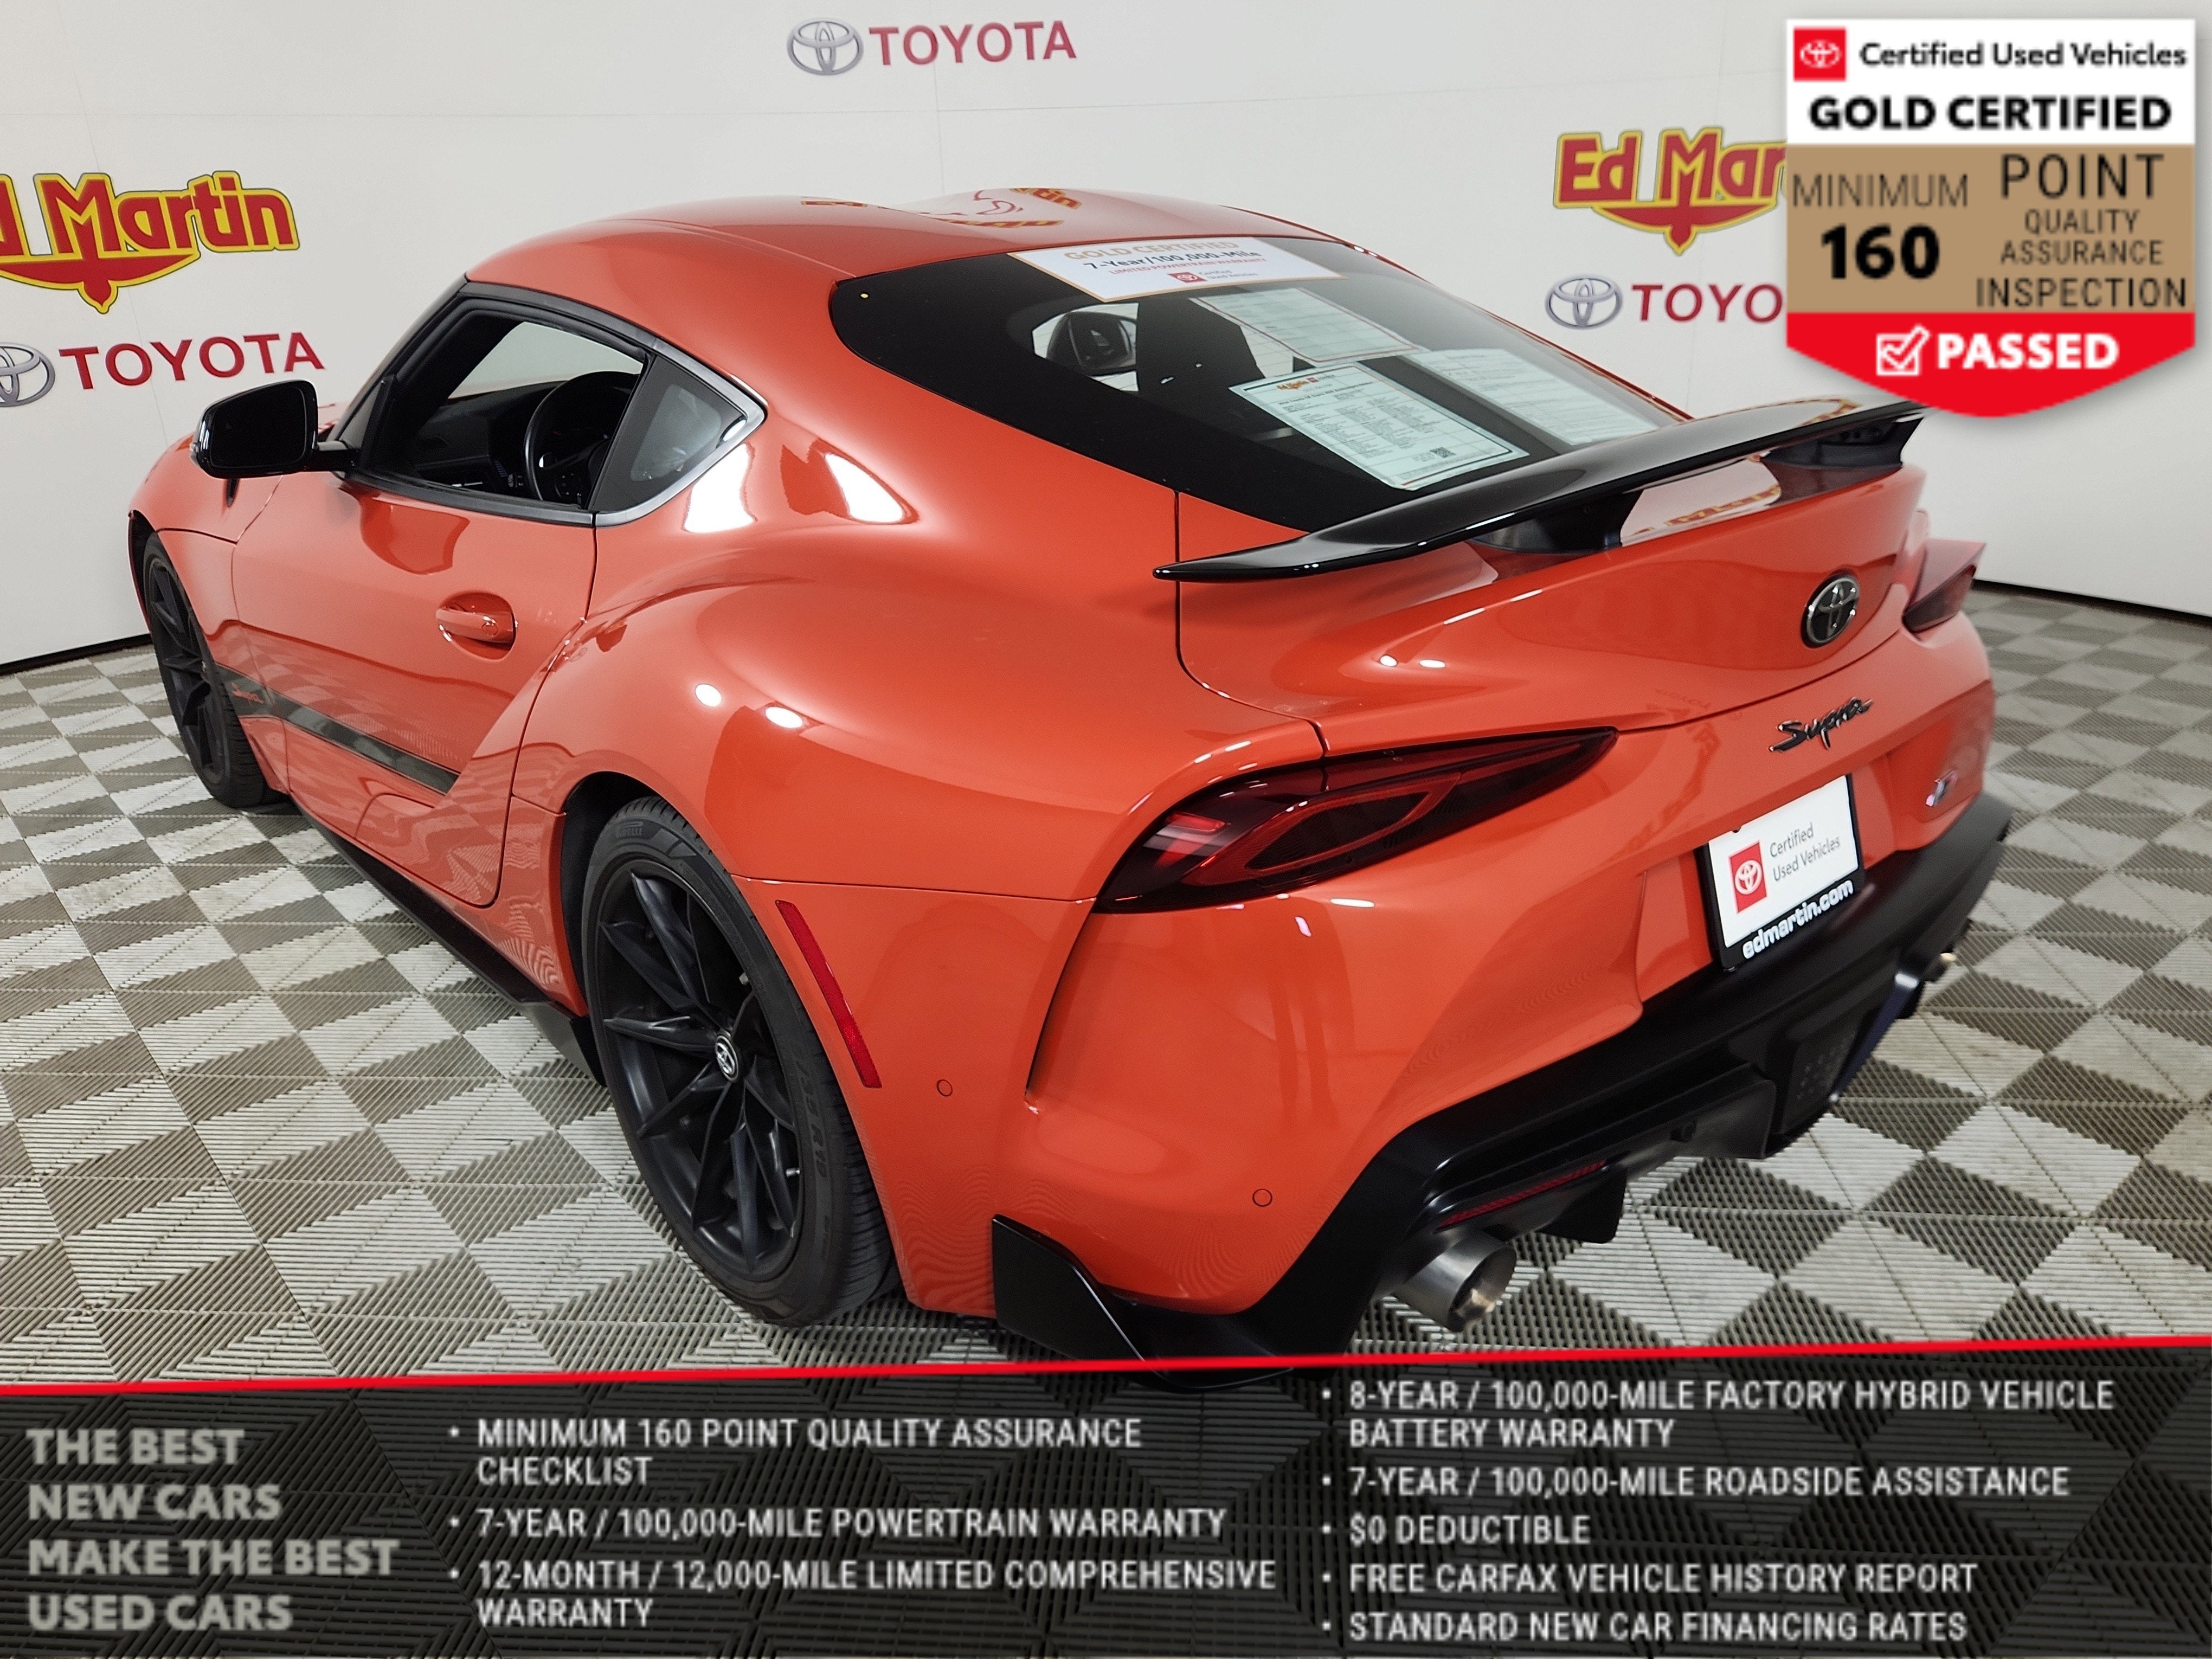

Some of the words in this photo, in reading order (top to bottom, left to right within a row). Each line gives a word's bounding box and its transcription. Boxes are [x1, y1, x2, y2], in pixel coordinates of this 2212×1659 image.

[869, 21, 1077, 65] TOYOTA
[1553, 130, 1642, 208] Ed
[1654, 127, 1786, 205] Mar
[34, 171, 300, 258] Martin
[1064, 248, 1132, 260] GOLD
[1133, 242, 1239, 253] CERTIFIED
[1632, 284, 1783, 323] TOYO
[59, 332, 325, 390] TOYOTA
[1769, 697, 1874, 752] Supra
[1769, 822, 1815, 859] Certified
[1773, 858, 1799, 882] Used
[1801, 835, 1841, 868] Vehicles
[1742, 879, 1854, 959] edmartin.com
